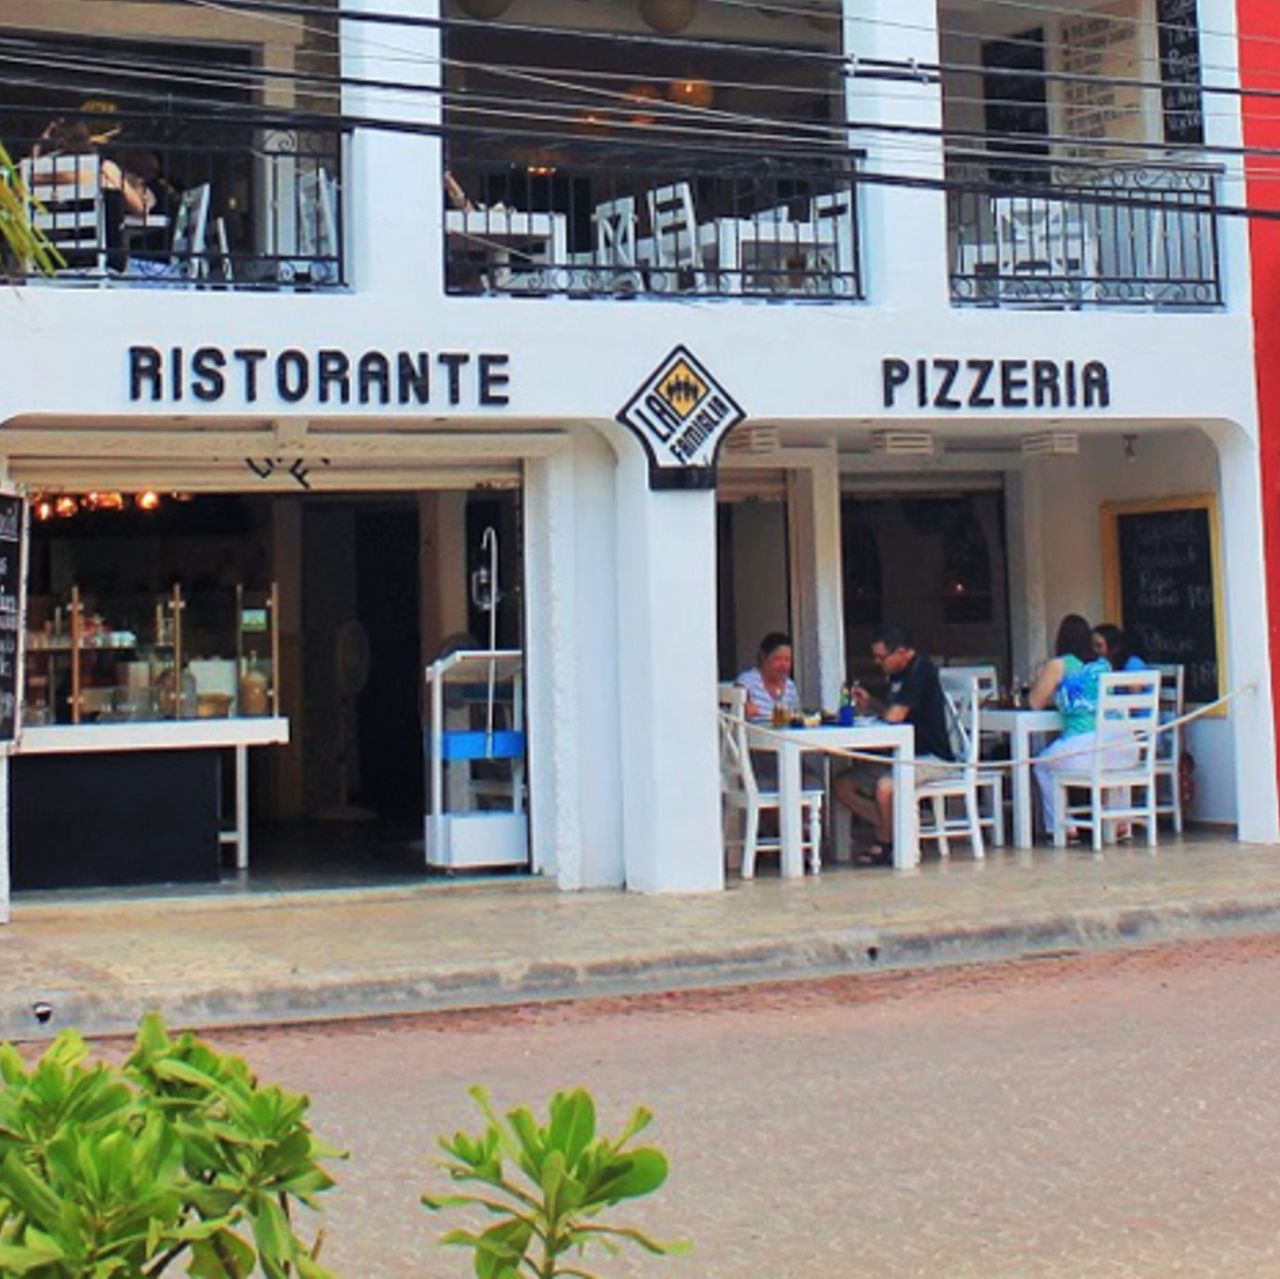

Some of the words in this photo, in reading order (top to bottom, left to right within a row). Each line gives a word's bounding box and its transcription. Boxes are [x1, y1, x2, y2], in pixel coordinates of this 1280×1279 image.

[128, 346, 510, 406] RISTORANTE
[882, 359, 1110, 408] PIZZERIA
[634, 394, 682, 443] LA
[669, 394, 730, 465] FAMIGLIA
